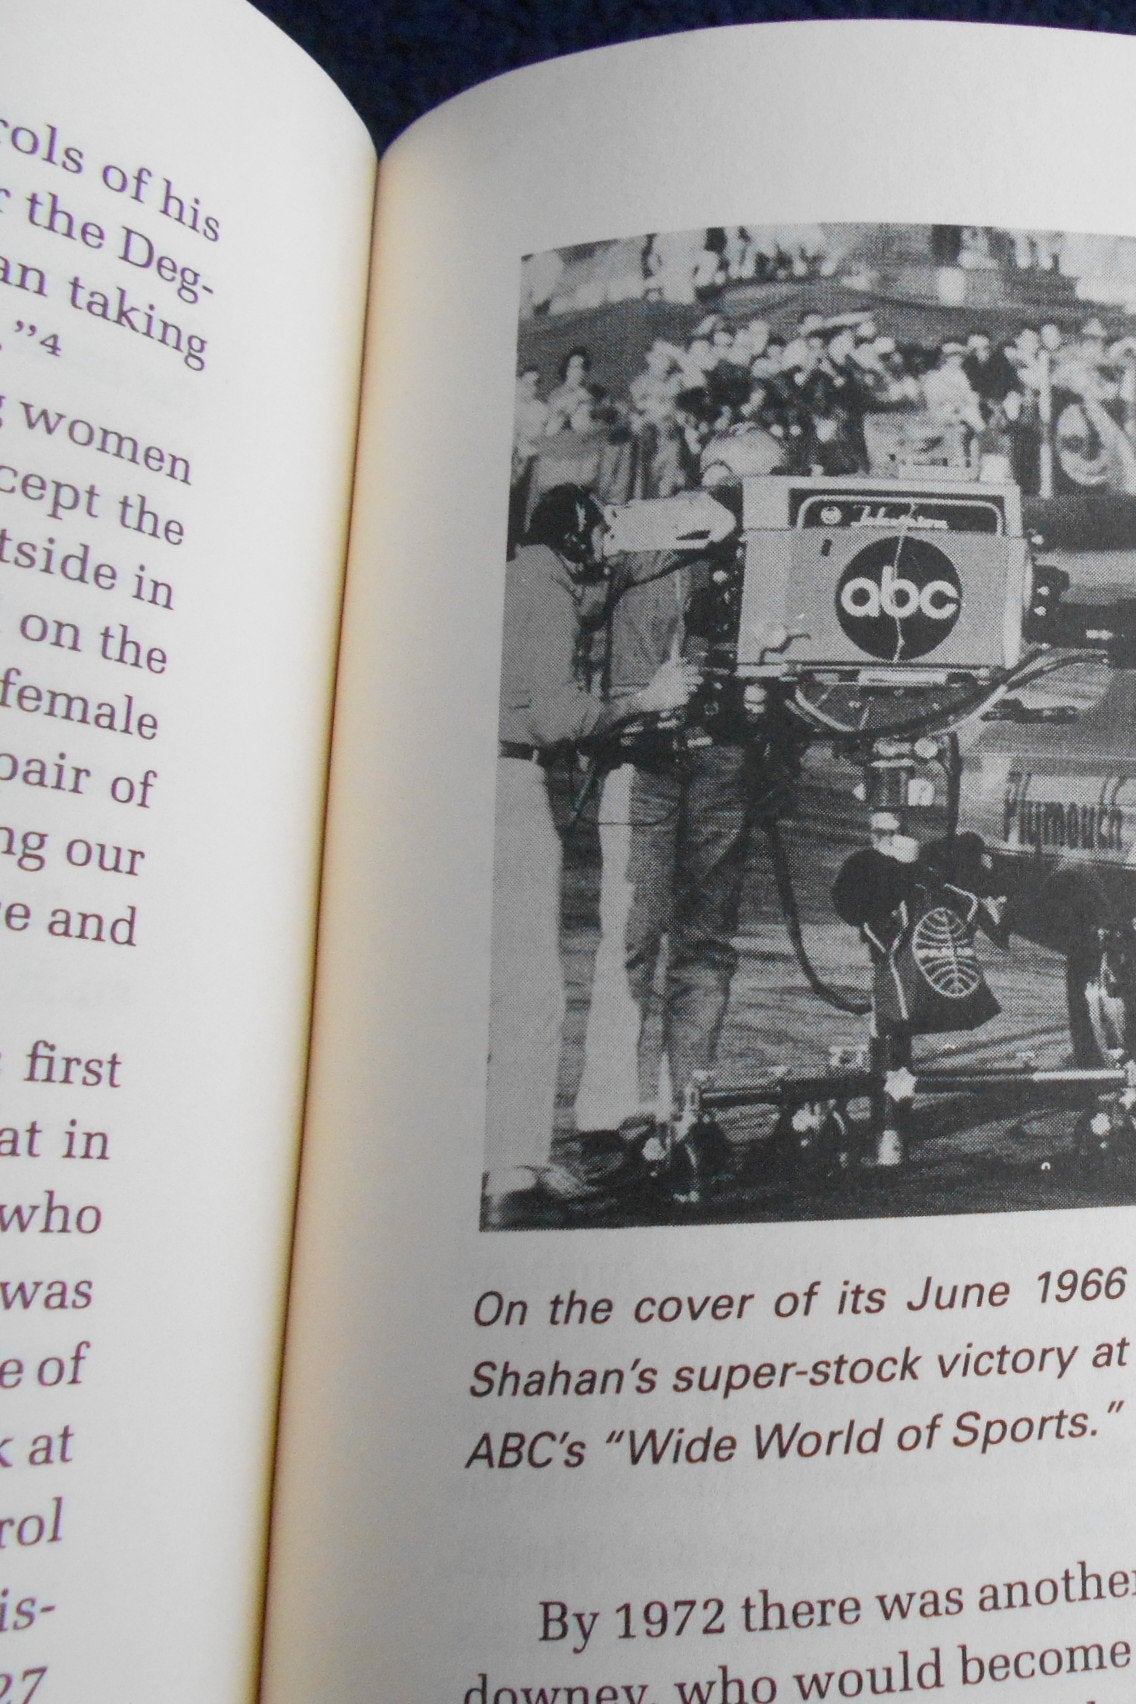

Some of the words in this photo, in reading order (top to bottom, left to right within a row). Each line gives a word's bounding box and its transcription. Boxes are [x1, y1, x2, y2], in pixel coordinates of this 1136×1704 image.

[0, 118, 83, 174] ols
[102, 165, 152, 203] of
[159, 178, 219, 242] his
[26, 192, 105, 249] the
[118, 225, 214, 305] Deg-
[68, 275, 208, 372] taking
[20, 401, 191, 485] women
[119, 494, 184, 545] the
[132, 564, 173, 610] in
[840, 565, 961, 620] abc
[20, 614, 81, 652] on
[100, 624, 167, 674] the
[0, 667, 158, 740] female
[110, 770, 158, 808] of
[66, 839, 145, 876] our
[47, 905, 136, 947] and
[24, 1040, 122, 1088] first
[0, 1121, 42, 1158] at
[62, 1119, 109, 1160] in
[0, 1190, 102, 1234] who
[0, 1280, 92, 1310] was
[474, 1290, 528, 1327] On
[550, 1289, 613, 1325] the
[634, 1294, 755, 1323] cover
[774, 1281, 821, 1318] of
[838, 1280, 886, 1315] its
[907, 1276, 1010, 1311] June
[1038, 1266, 1127, 1304] 1966
[37, 1340, 91, 1386] of
[673, 1346, 922, 1399] super-stock
[938, 1343, 1079, 1379] victory
[1092, 1337, 1130, 1368] at
[28, 1425, 74, 1466] at
[755, 1418, 884, 1460] World
[897, 1413, 943, 1451] of
[539, 1601, 599, 1654] By
[616, 1598, 725, 1639] 1972
[742, 1589, 861, 1632] there
[875, 1587, 963, 1621] was
[674, 1665, 777, 1704] who
[793, 1647, 944, 1701] would
[958, 1641, 1131, 1685] become
